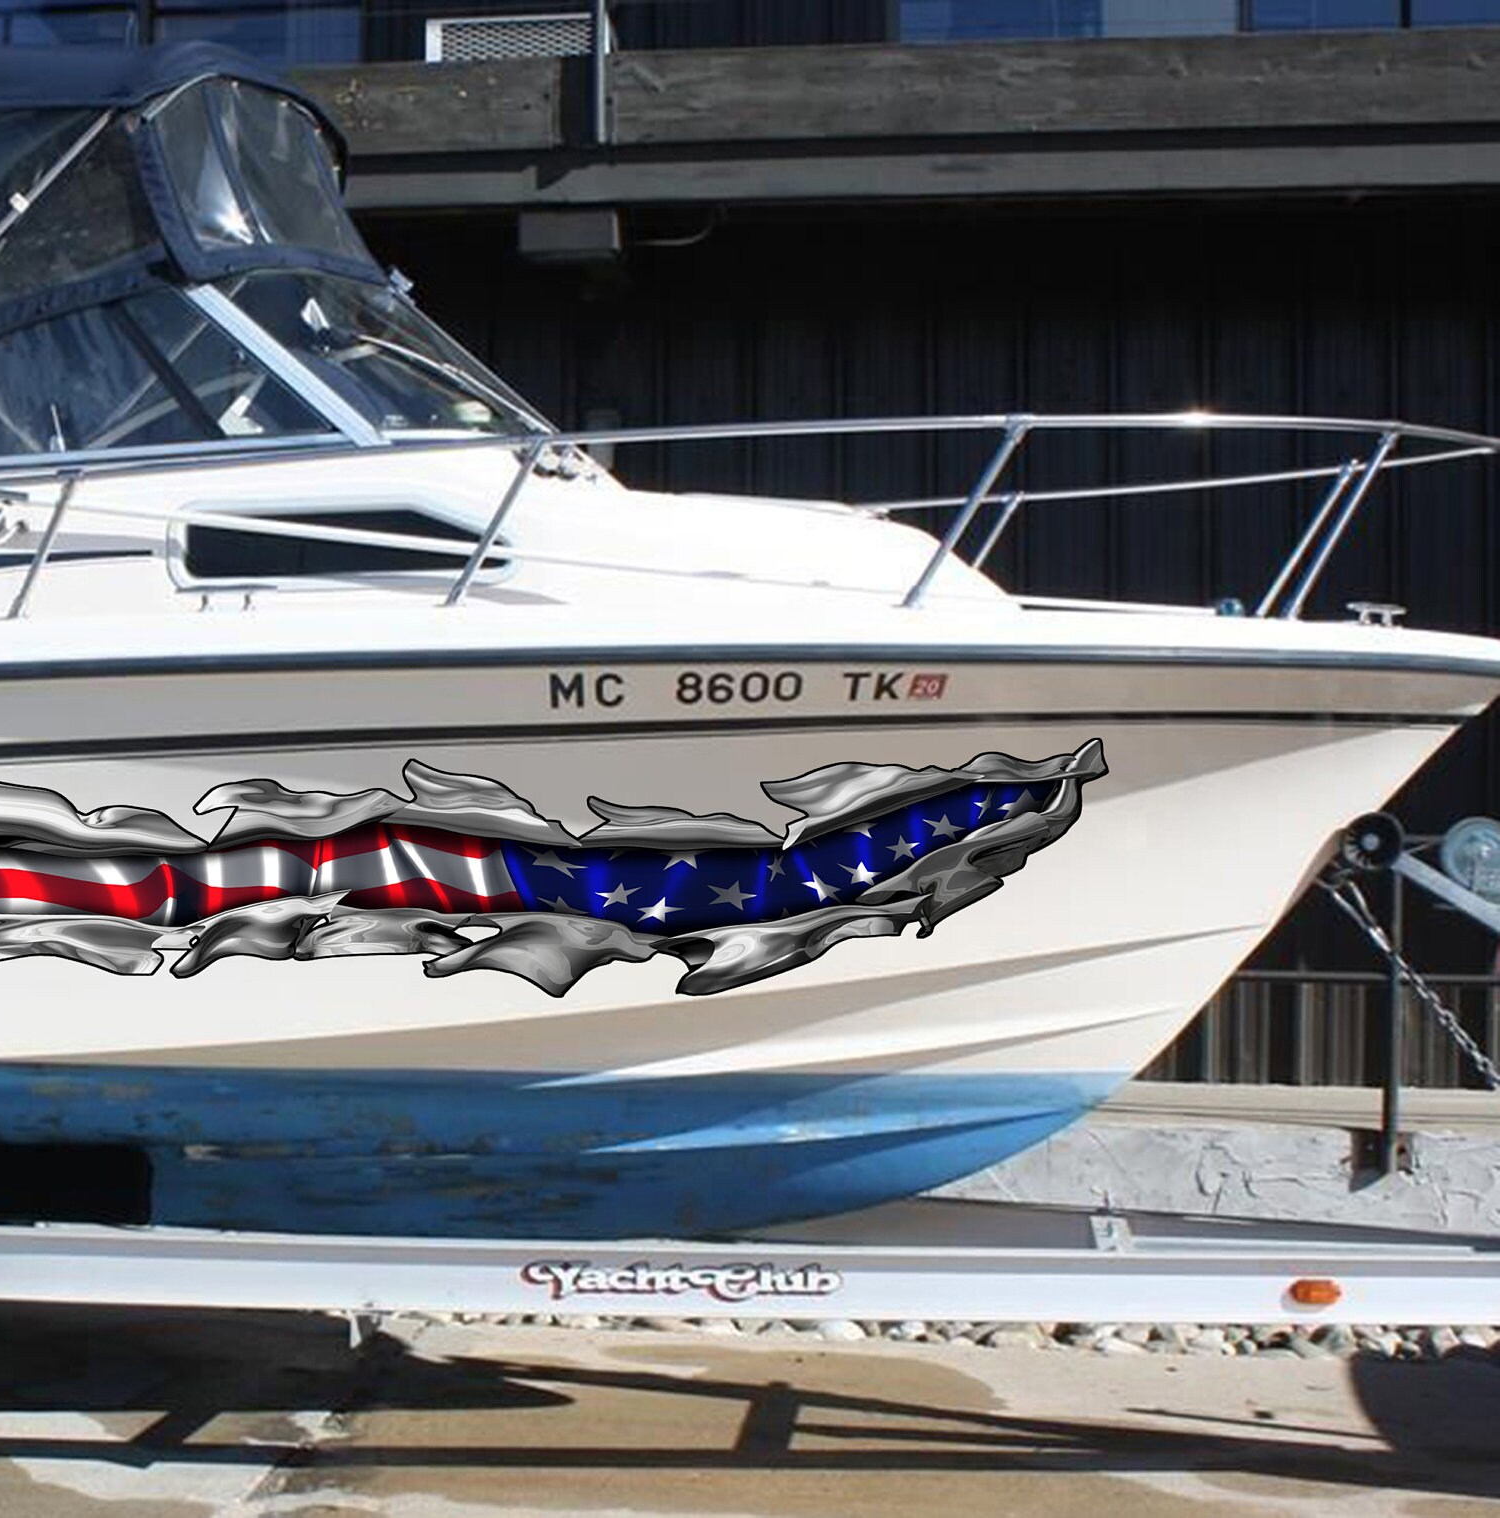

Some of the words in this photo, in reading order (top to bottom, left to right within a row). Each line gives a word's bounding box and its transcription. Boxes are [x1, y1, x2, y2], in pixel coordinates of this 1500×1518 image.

[549, 673, 625, 708] MC
[676, 671, 803, 704] 8600
[843, 672, 904, 701] TK
[913, 679, 940, 696] 20
